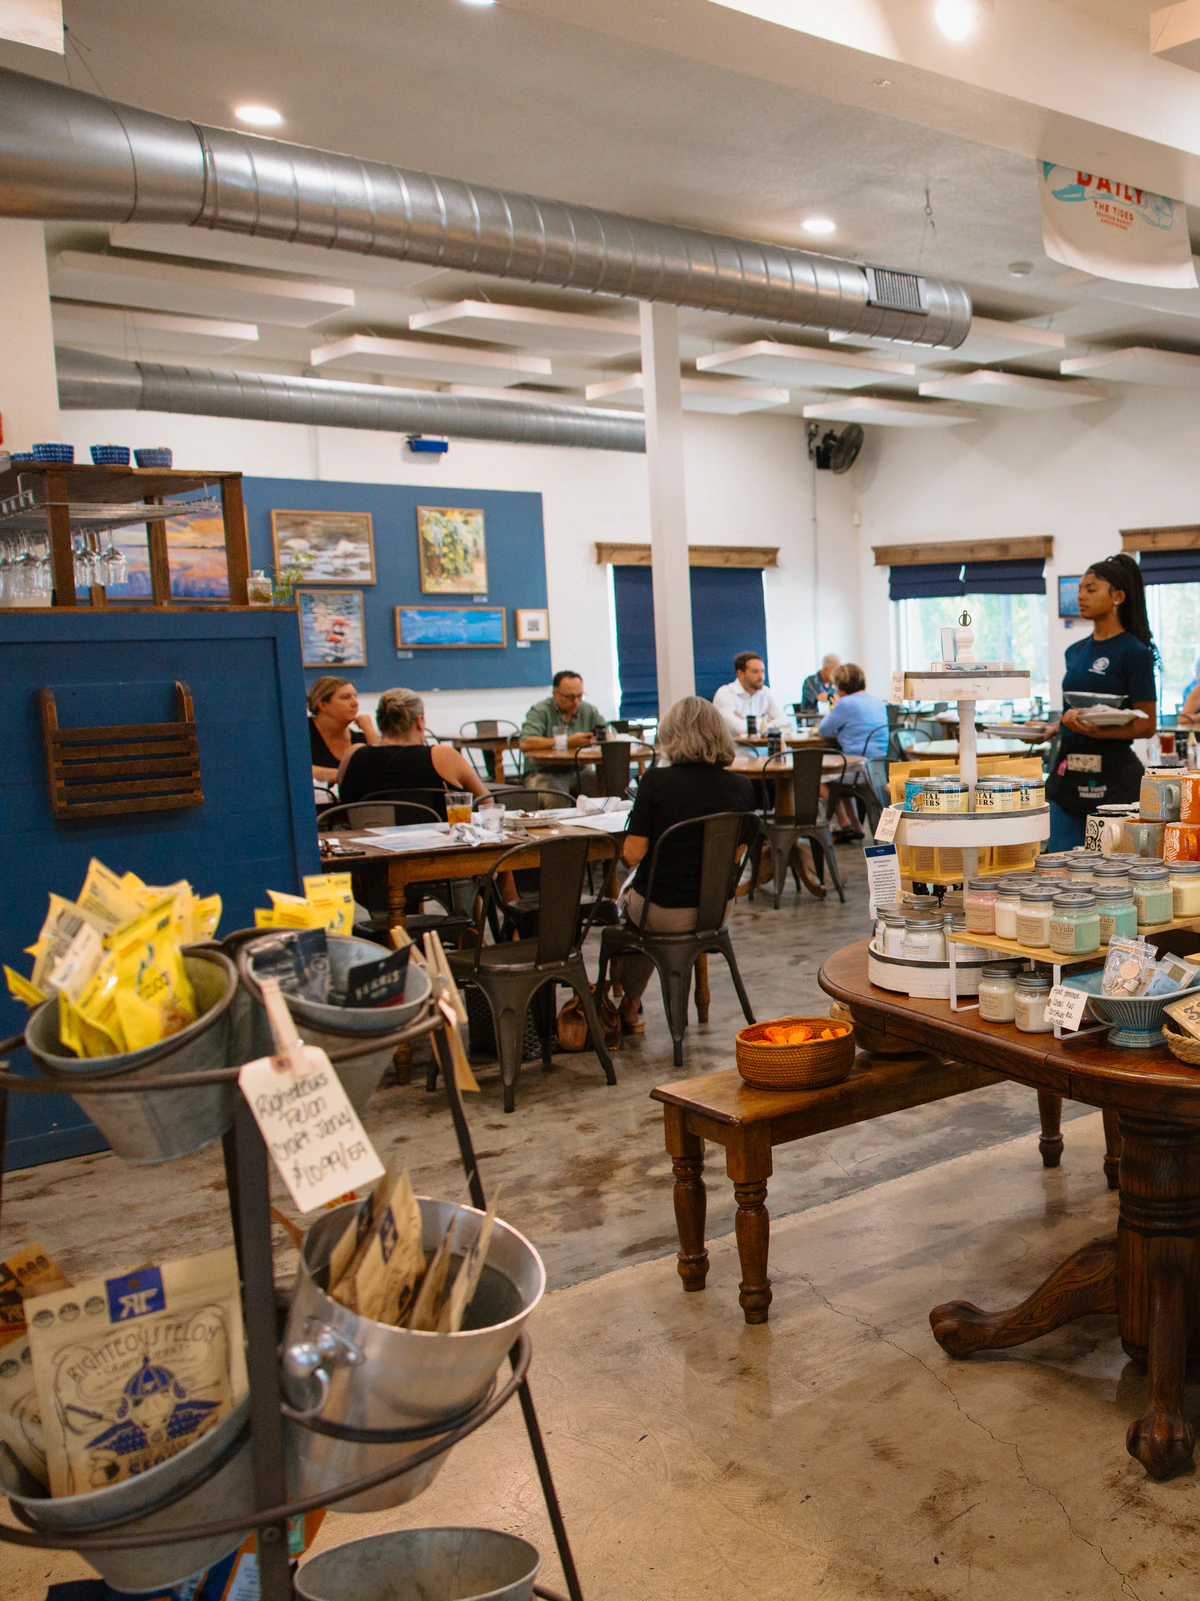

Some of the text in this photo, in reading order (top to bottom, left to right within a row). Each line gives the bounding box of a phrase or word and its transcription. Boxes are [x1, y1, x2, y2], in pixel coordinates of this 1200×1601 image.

[1093, 200, 1134, 221] THE TIDES
[1060, 923, 1074, 933] Vida
[66, 1320, 219, 1385] RIGHTEOUS FELON
